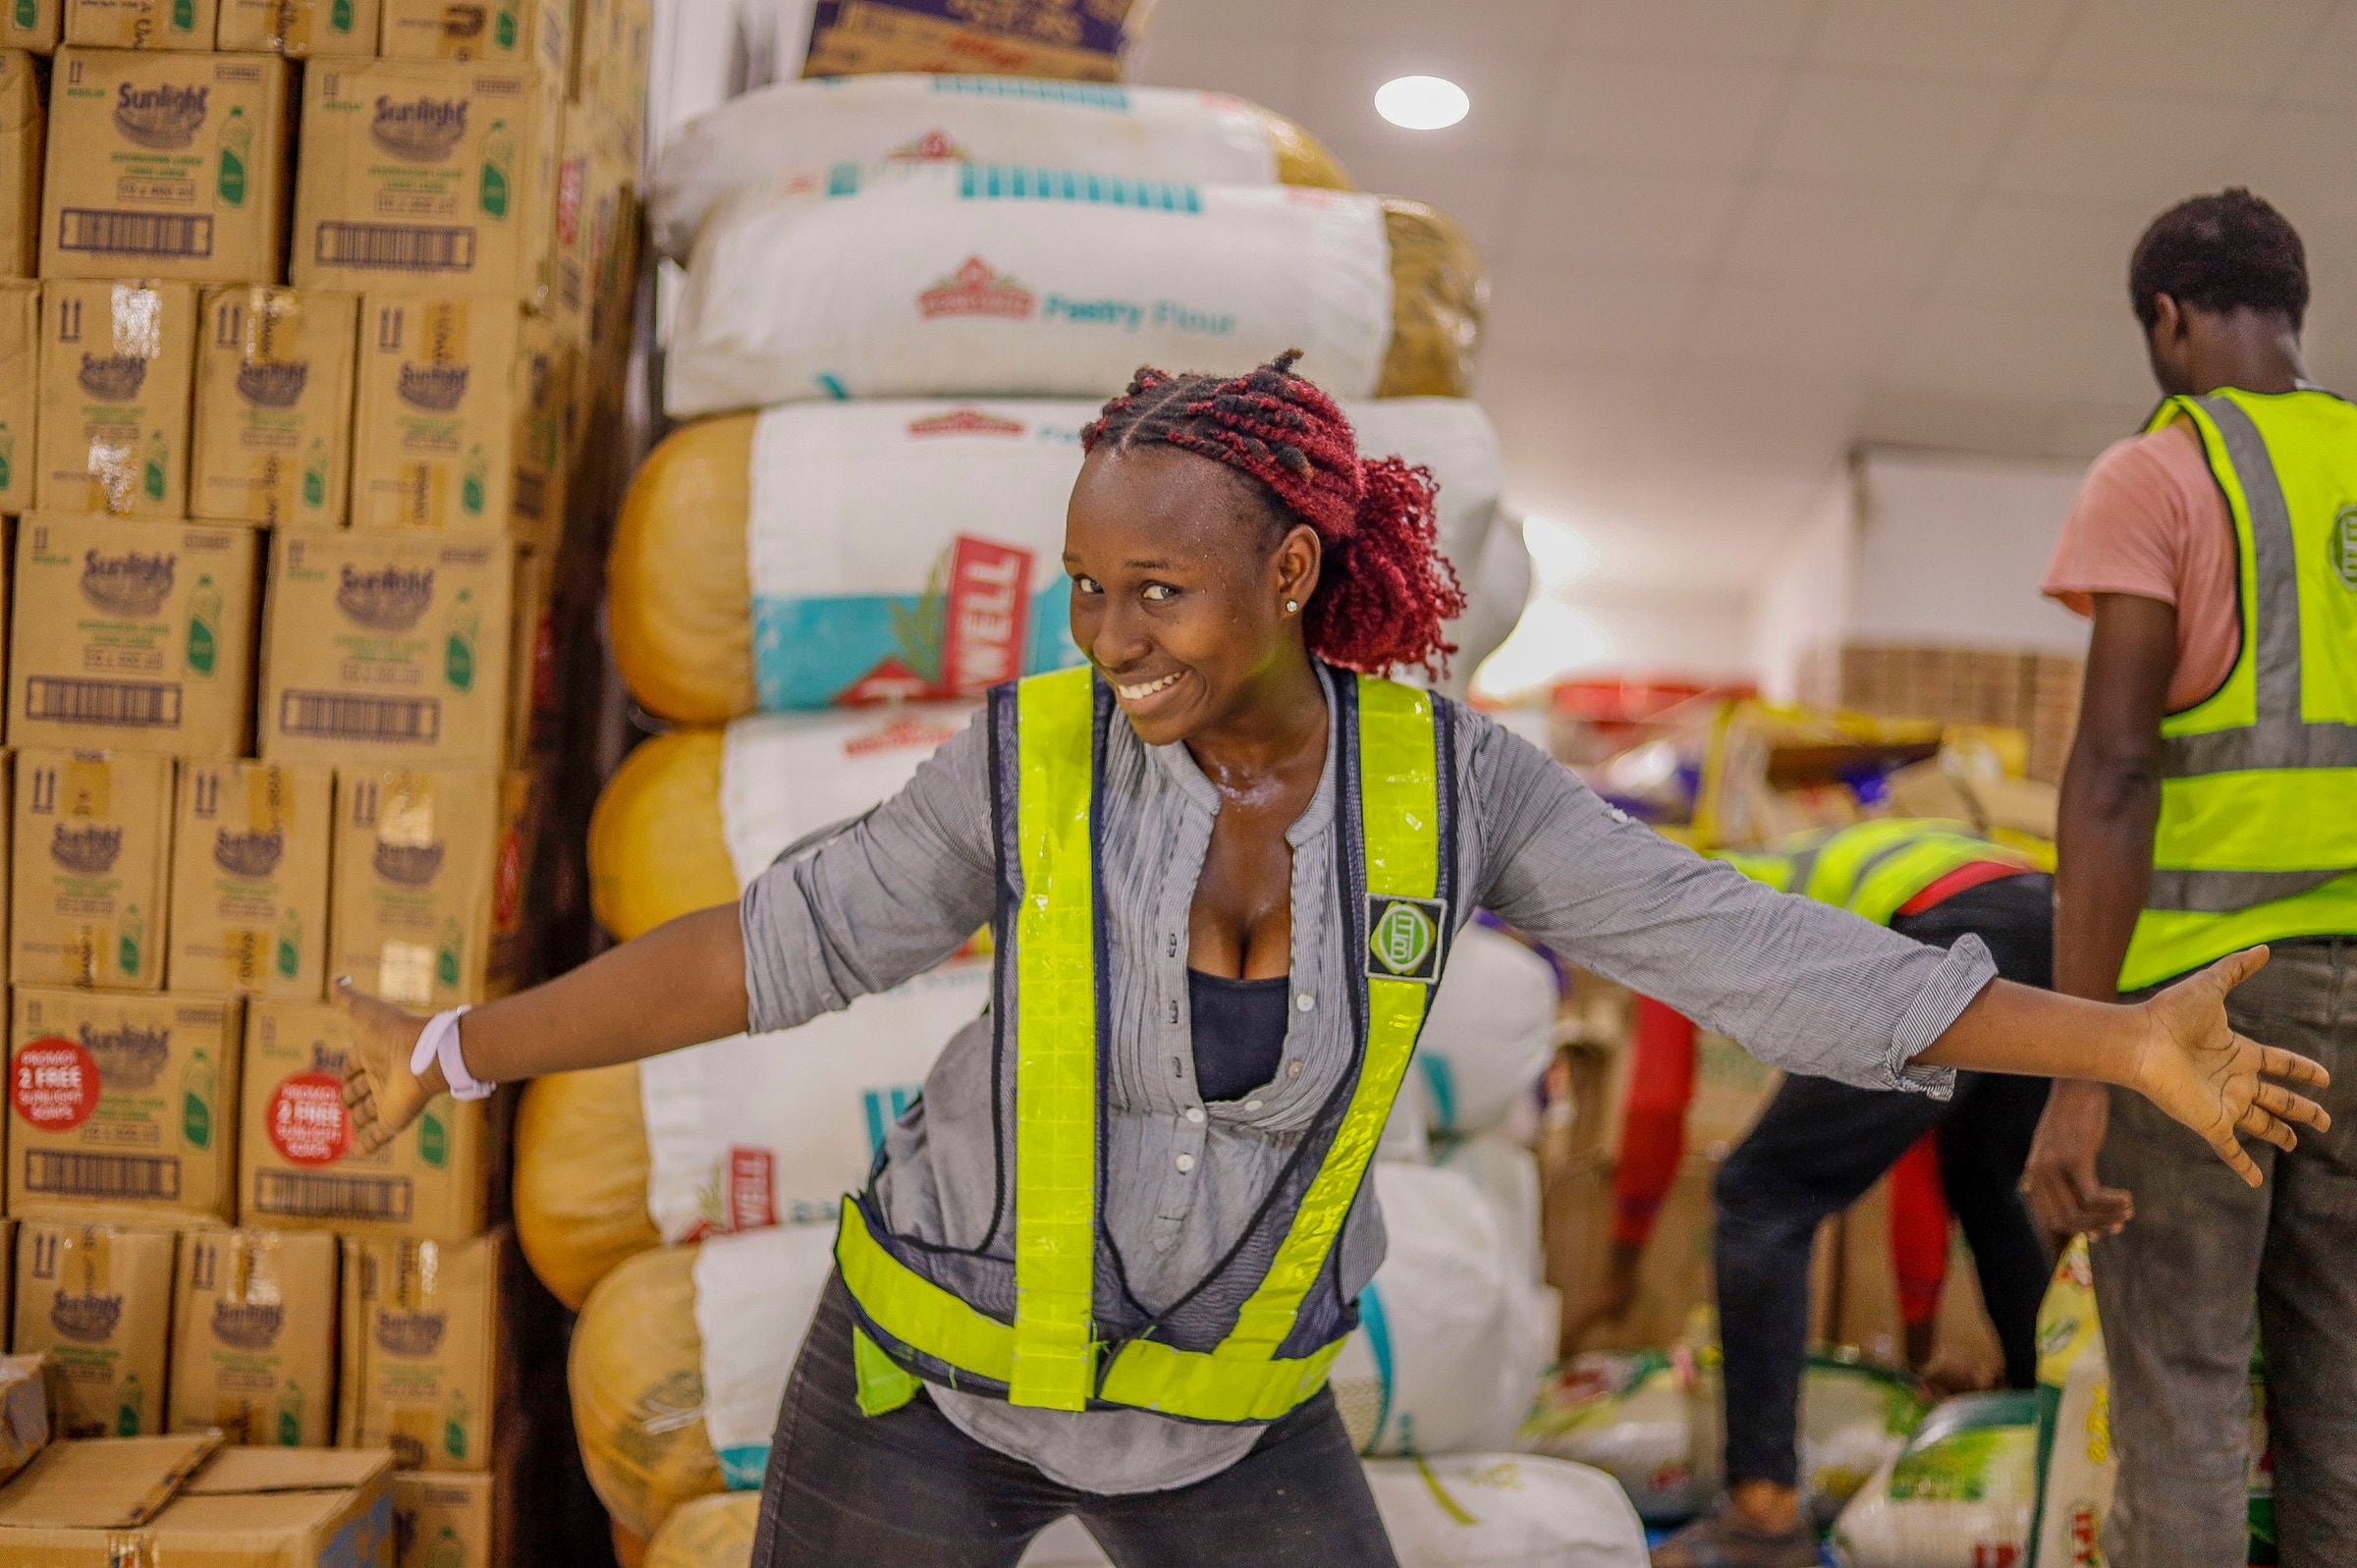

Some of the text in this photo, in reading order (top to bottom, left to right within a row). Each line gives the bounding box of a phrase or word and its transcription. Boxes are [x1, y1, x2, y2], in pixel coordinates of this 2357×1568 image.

[117, 81, 210, 115] Sunlight
[373, 95, 468, 127] Sunlight
[1042, 292, 1144, 333] Pastry
[84, 548, 177, 582] Sunlight
[79, 1020, 170, 1056] Sunlight
[18, 1064, 82, 1089] 2 FREE
[276, 1099, 343, 1126] 2 FREE
